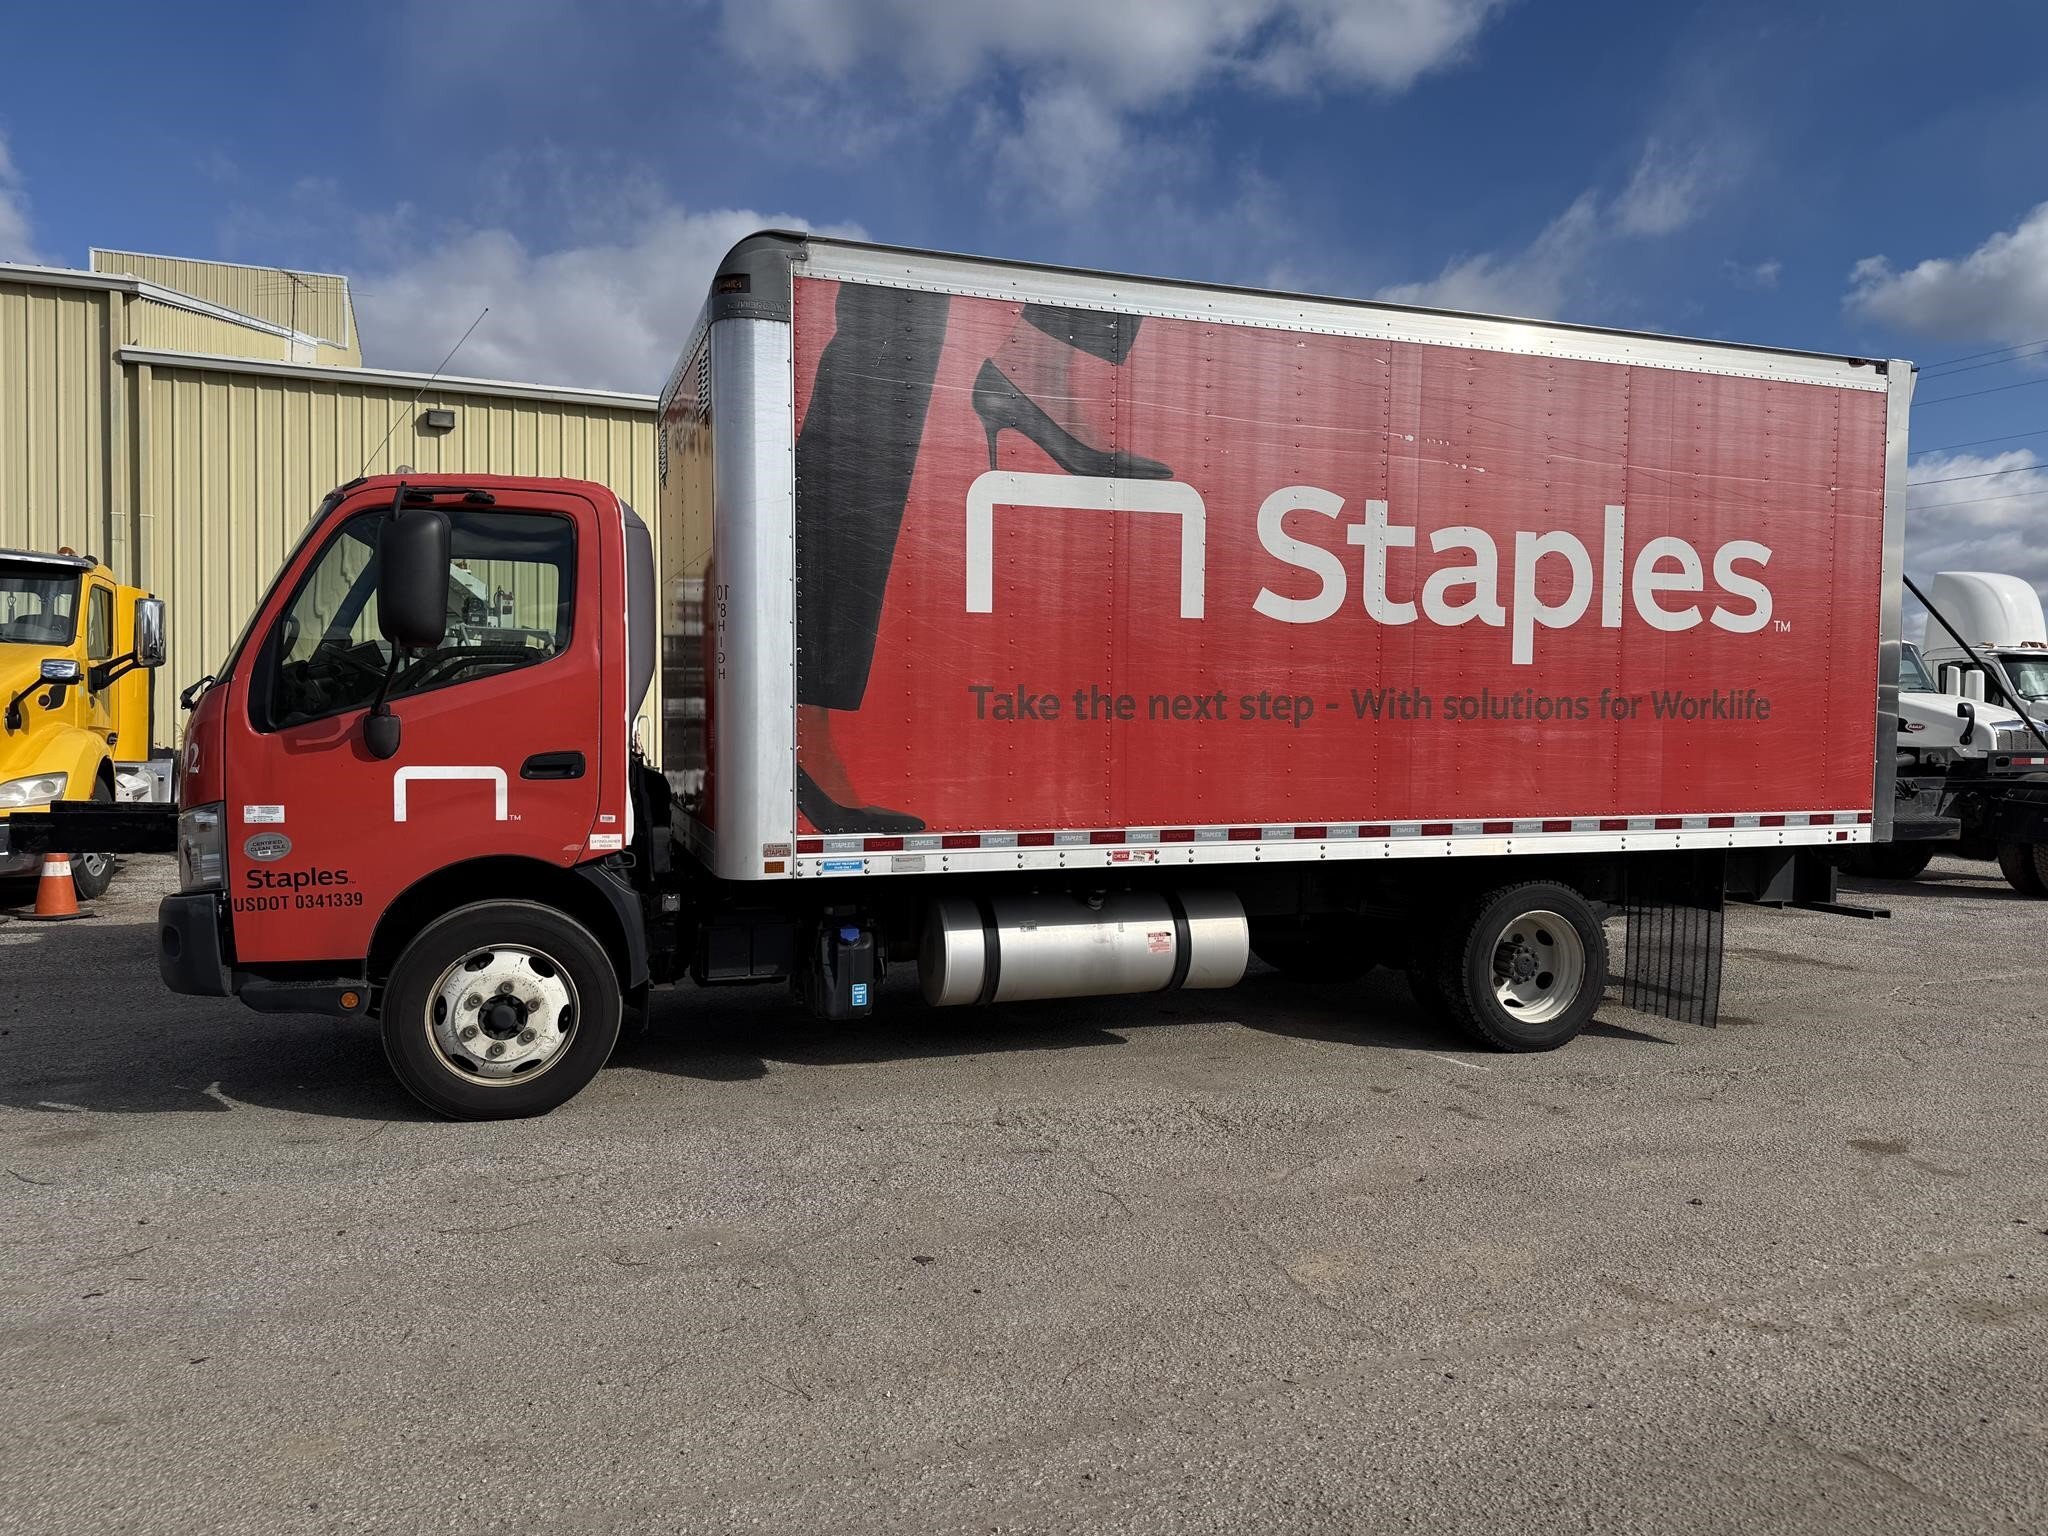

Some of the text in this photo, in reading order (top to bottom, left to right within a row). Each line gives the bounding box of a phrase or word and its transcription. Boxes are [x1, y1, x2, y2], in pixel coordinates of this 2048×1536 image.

[1252, 485, 1791, 665] Staples TM
[967, 684, 1060, 721] Take
[1071, 684, 1136, 720] the
[1149, 689, 1228, 720] next
[1239, 689, 1314, 728] step
[1351, 688, 1432, 720] With
[1443, 688, 1589, 720] solutions
[1600, 688, 1643, 720] for
[1650, 689, 1771, 720] Worklife
[830, 841, 856, 849] STAPLES
[246, 867, 349, 892] Staples
[234, 892, 363, 913] USDOT 0341339
